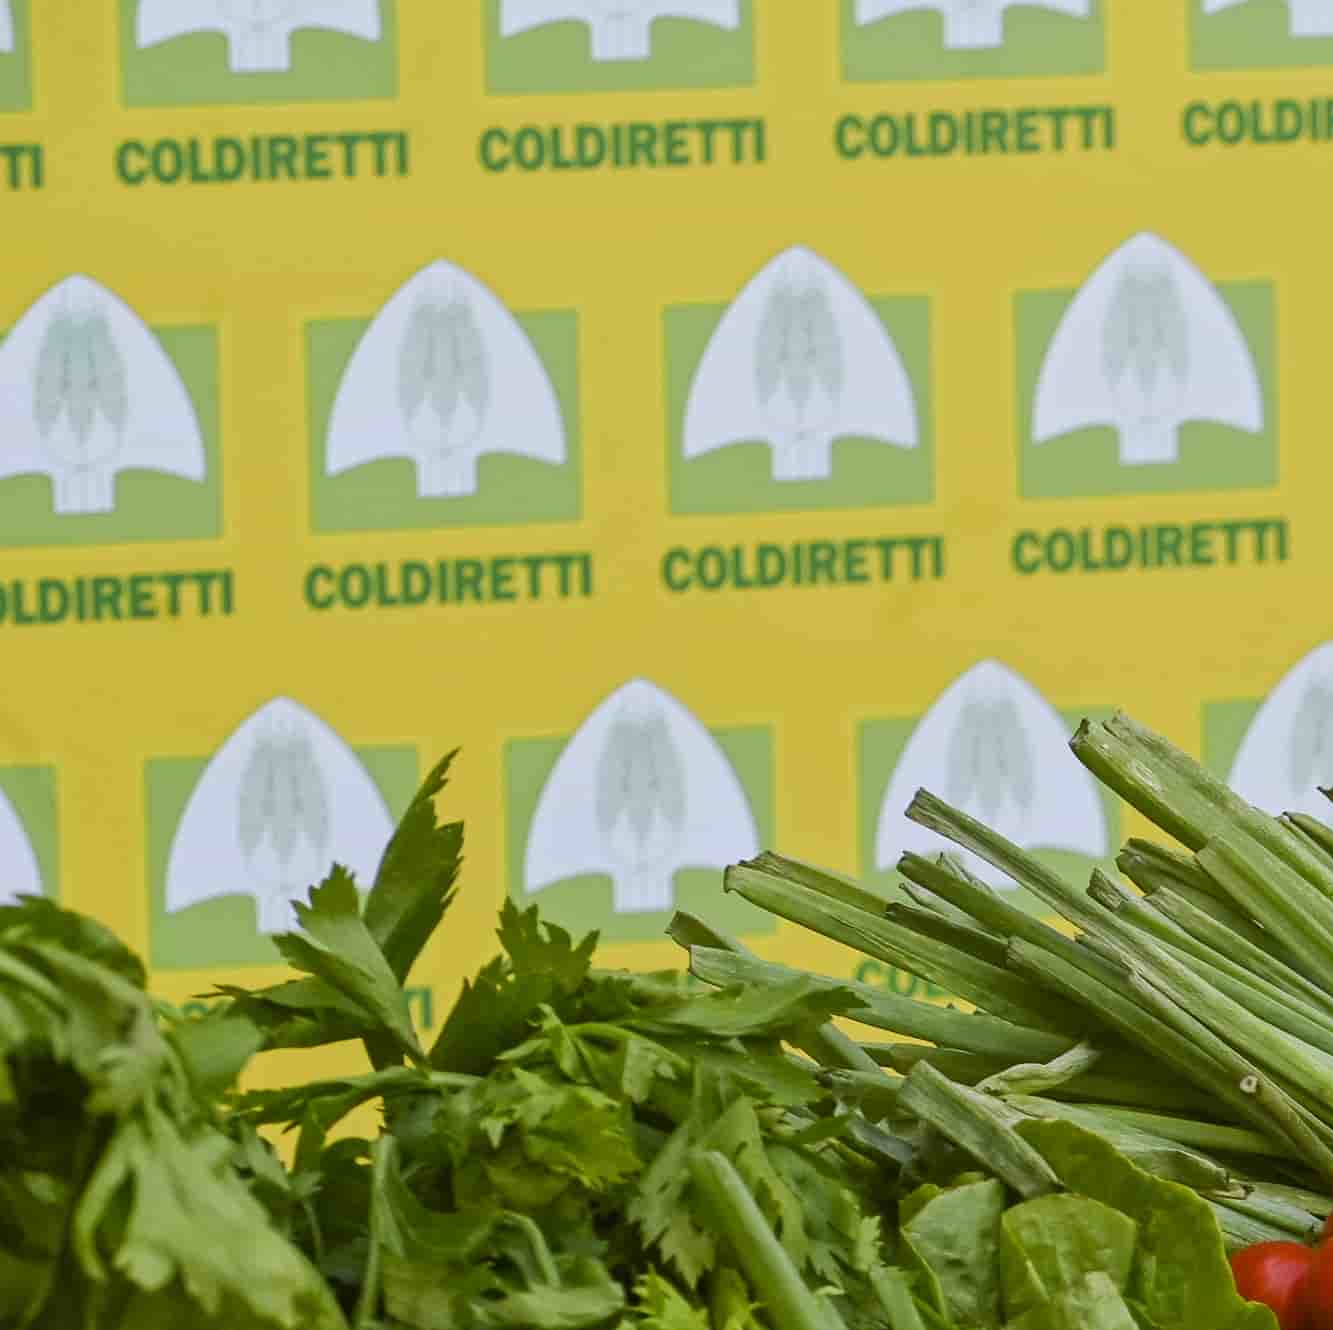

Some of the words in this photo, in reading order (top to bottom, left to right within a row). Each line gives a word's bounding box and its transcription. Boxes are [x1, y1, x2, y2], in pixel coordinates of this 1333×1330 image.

[117, 132, 409, 185] COLDIRETTI
[480, 120, 766, 172] COLDIRETTI
[836, 108, 1114, 159] COLDIRETTI
[663, 537, 945, 592] COLDIRETTI
[1013, 520, 1288, 574] COLDIRETTI
[0, 570, 234, 625] LDIRETTI
[305, 554, 594, 609] COLDIRETTI
